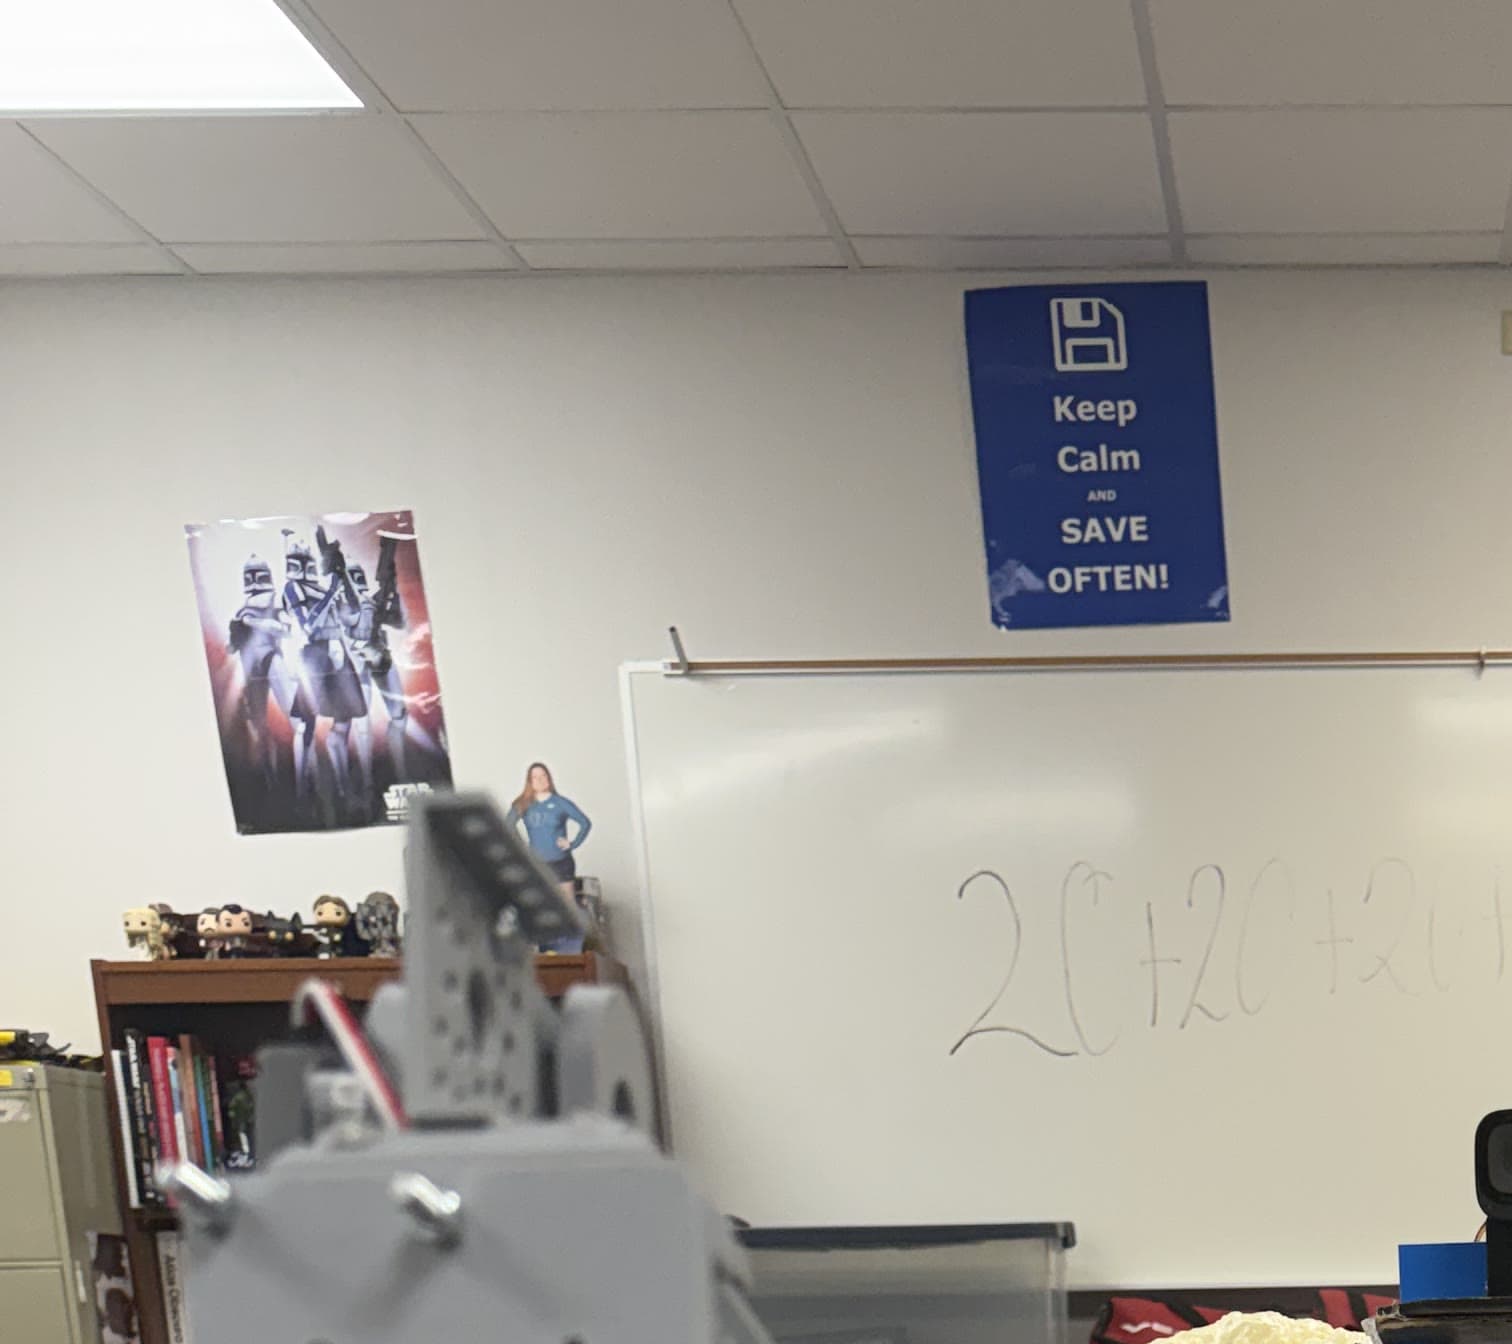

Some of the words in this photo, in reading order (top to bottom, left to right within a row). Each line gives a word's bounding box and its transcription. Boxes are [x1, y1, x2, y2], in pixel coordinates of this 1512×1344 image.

[1053, 395, 1137, 426] Keep
[1057, 444, 1140, 472] Calm
[1087, 489, 1117, 502] AND
[1061, 516, 1149, 544] SAVE
[1047, 564, 1169, 593] OFTEN!
